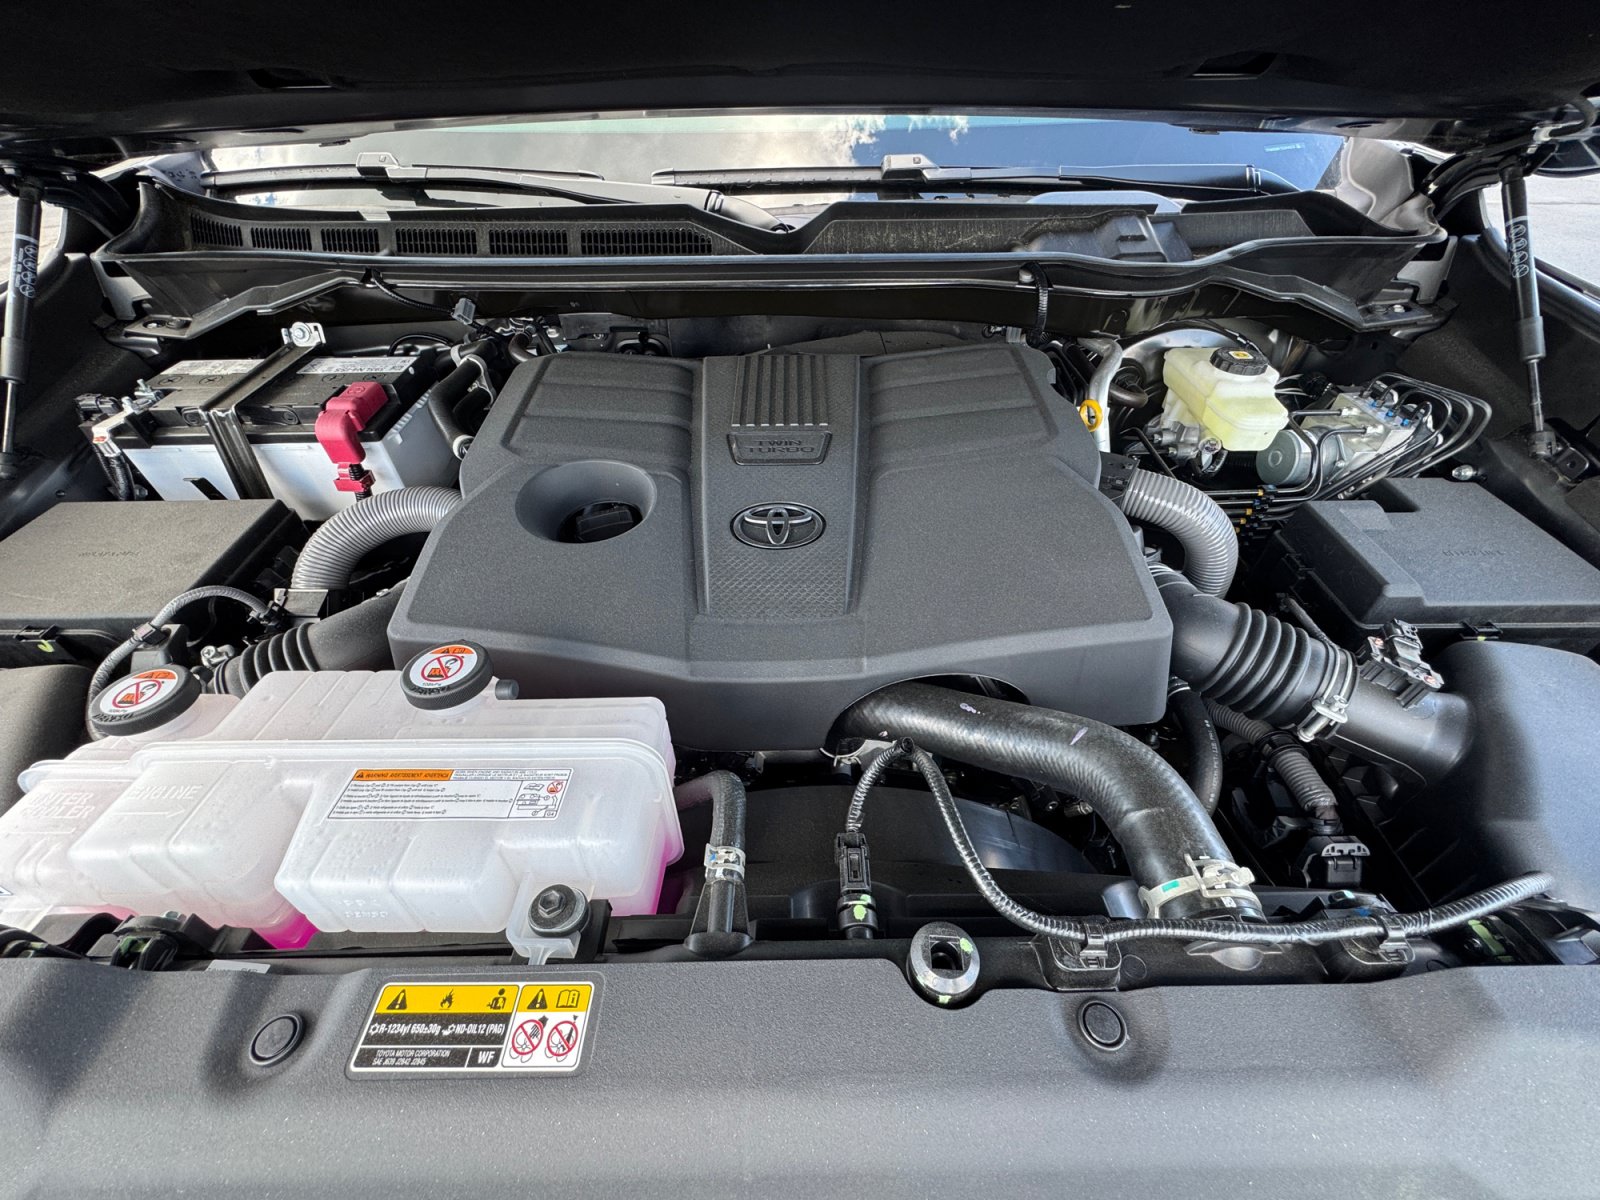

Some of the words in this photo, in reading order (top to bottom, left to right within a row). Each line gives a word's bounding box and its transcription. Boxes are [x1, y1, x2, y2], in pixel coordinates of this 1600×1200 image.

[126, 784, 203, 800] ENGINE
[379, 1023, 412, 1036] R-1234yf
[410, 1023, 442, 1036] 650±30g
[485, 1023, 506, 1036] (PAG)
[375, 1049, 396, 1057] TOYOTA
[395, 1049, 415, 1057] MOTOR
[414, 1049, 452, 1057] CORPORATION
[477, 1051, 495, 1064] WF
[372, 1057, 383, 1066] SAE
